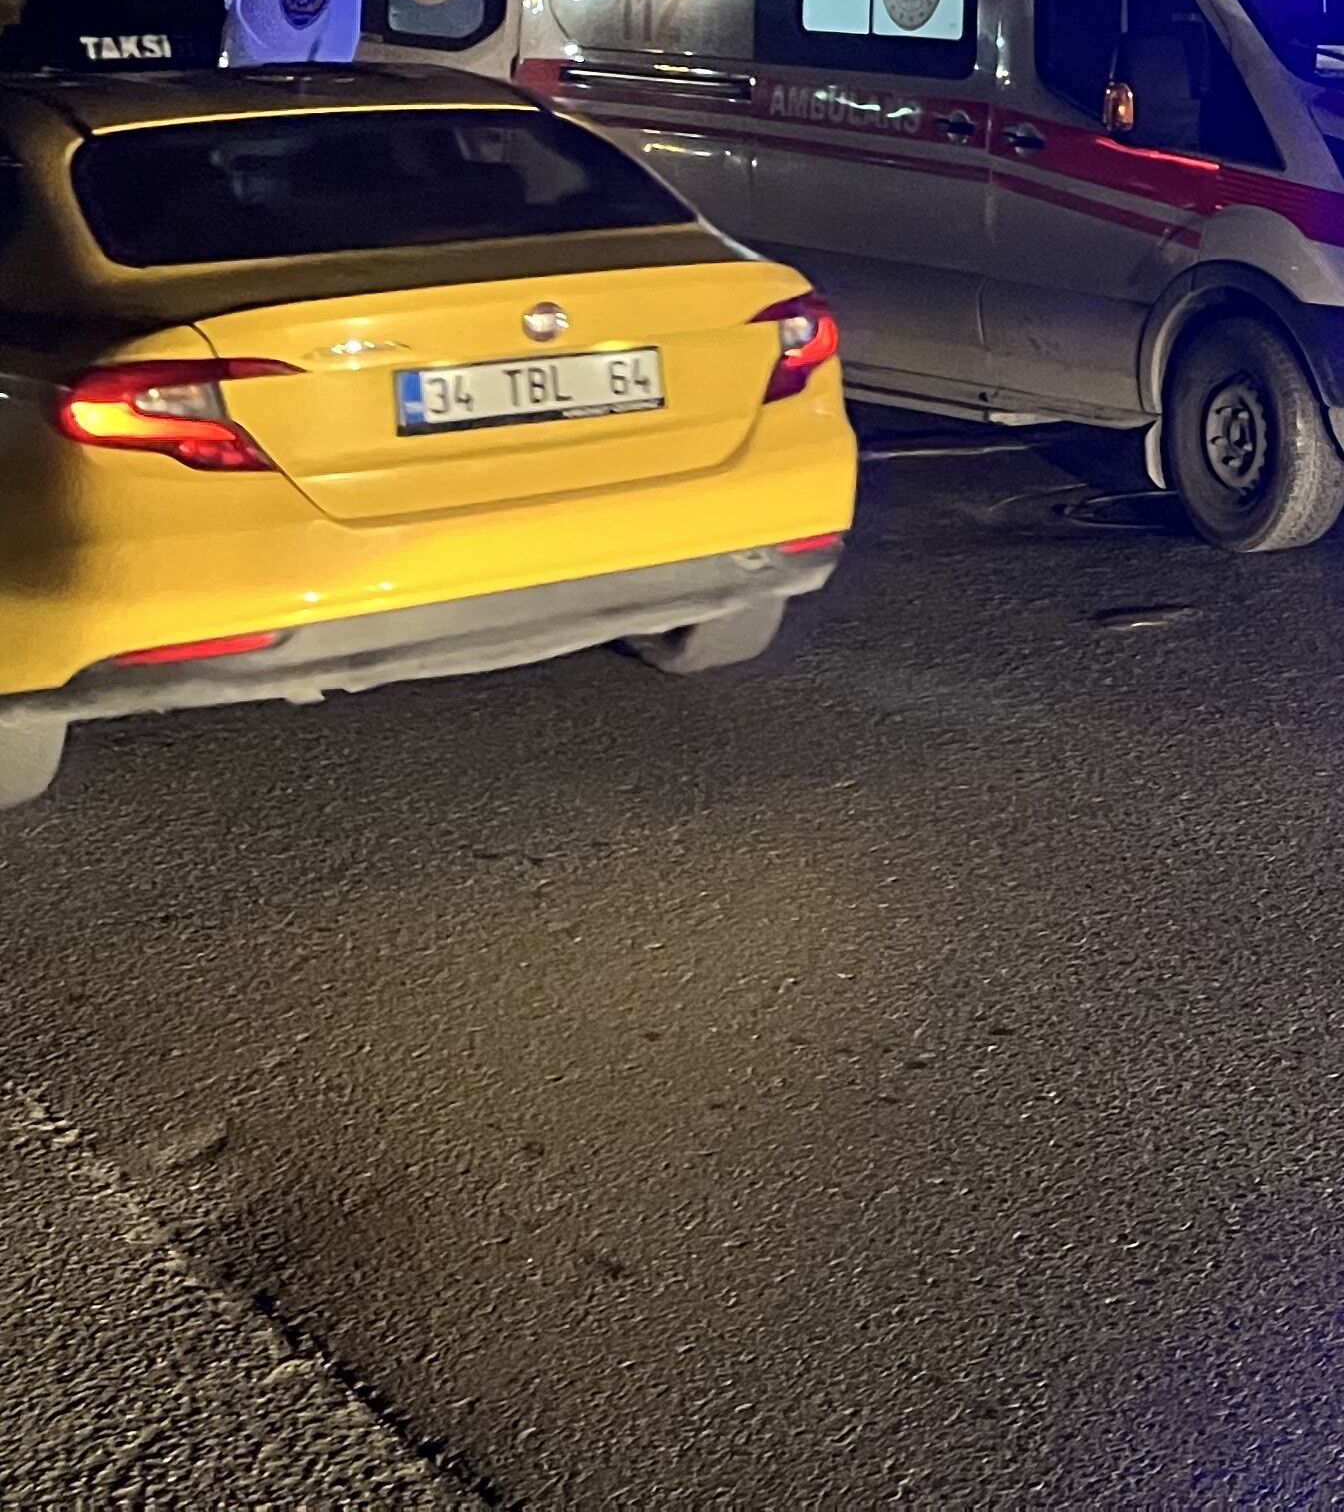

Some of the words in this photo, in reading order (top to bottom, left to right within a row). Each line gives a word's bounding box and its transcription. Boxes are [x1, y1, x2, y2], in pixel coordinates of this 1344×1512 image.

[427, 376, 474, 414] 34
[504, 364, 571, 407] TBL
[608, 358, 651, 395] 64
